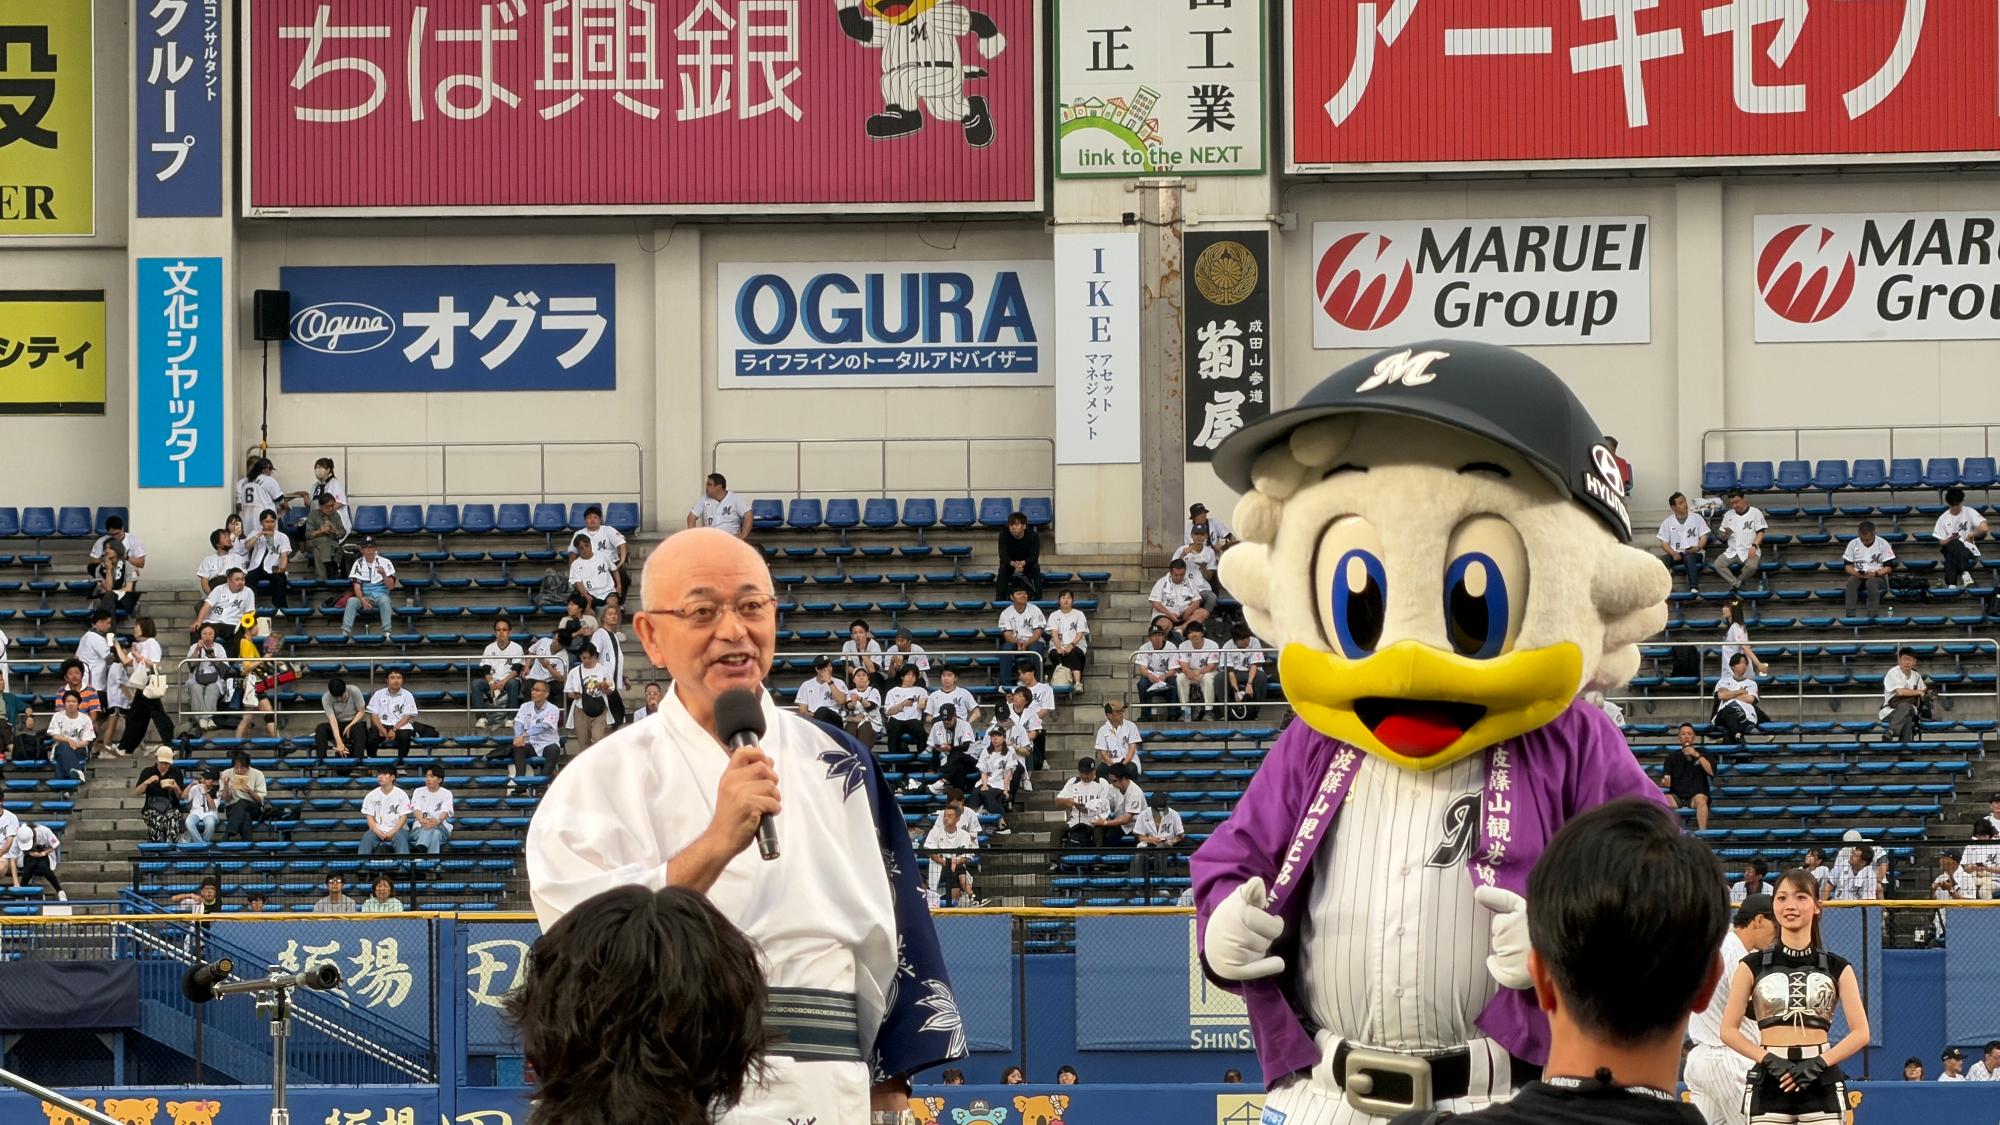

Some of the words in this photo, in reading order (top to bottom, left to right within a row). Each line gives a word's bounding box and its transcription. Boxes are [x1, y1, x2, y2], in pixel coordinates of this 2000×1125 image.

[203, 0, 218, 101] コンサルタント
[278, 0, 803, 122] ちば興銀
[1079, 149, 1116, 166] link
[1123, 150, 1143, 165] to
[1148, 148, 1183, 165] the
[1190, 146, 1243, 163] NEXT
[1416, 223, 1647, 274] MARUEI
[1858, 218, 2000, 267] MAR
[297, 309, 389, 350] Ogura
[402, 290, 608, 370] オグラ
[735, 272, 1038, 345] OGURA
[1086, 248, 1113, 343] IKE
[1433, 281, 1619, 336] Group
[163, 261, 198, 483] 文化シャッター
[741, 350, 1034, 371] ライフラインのトータルアドバイザー
[1085, 354, 1099, 440] マネジメント
[1100, 354, 1113, 412] アセット
[1193, 319, 1246, 450] 菊屋
[1248, 319, 1264, 404] 成田山参道
[245, 487, 254, 503] 6
